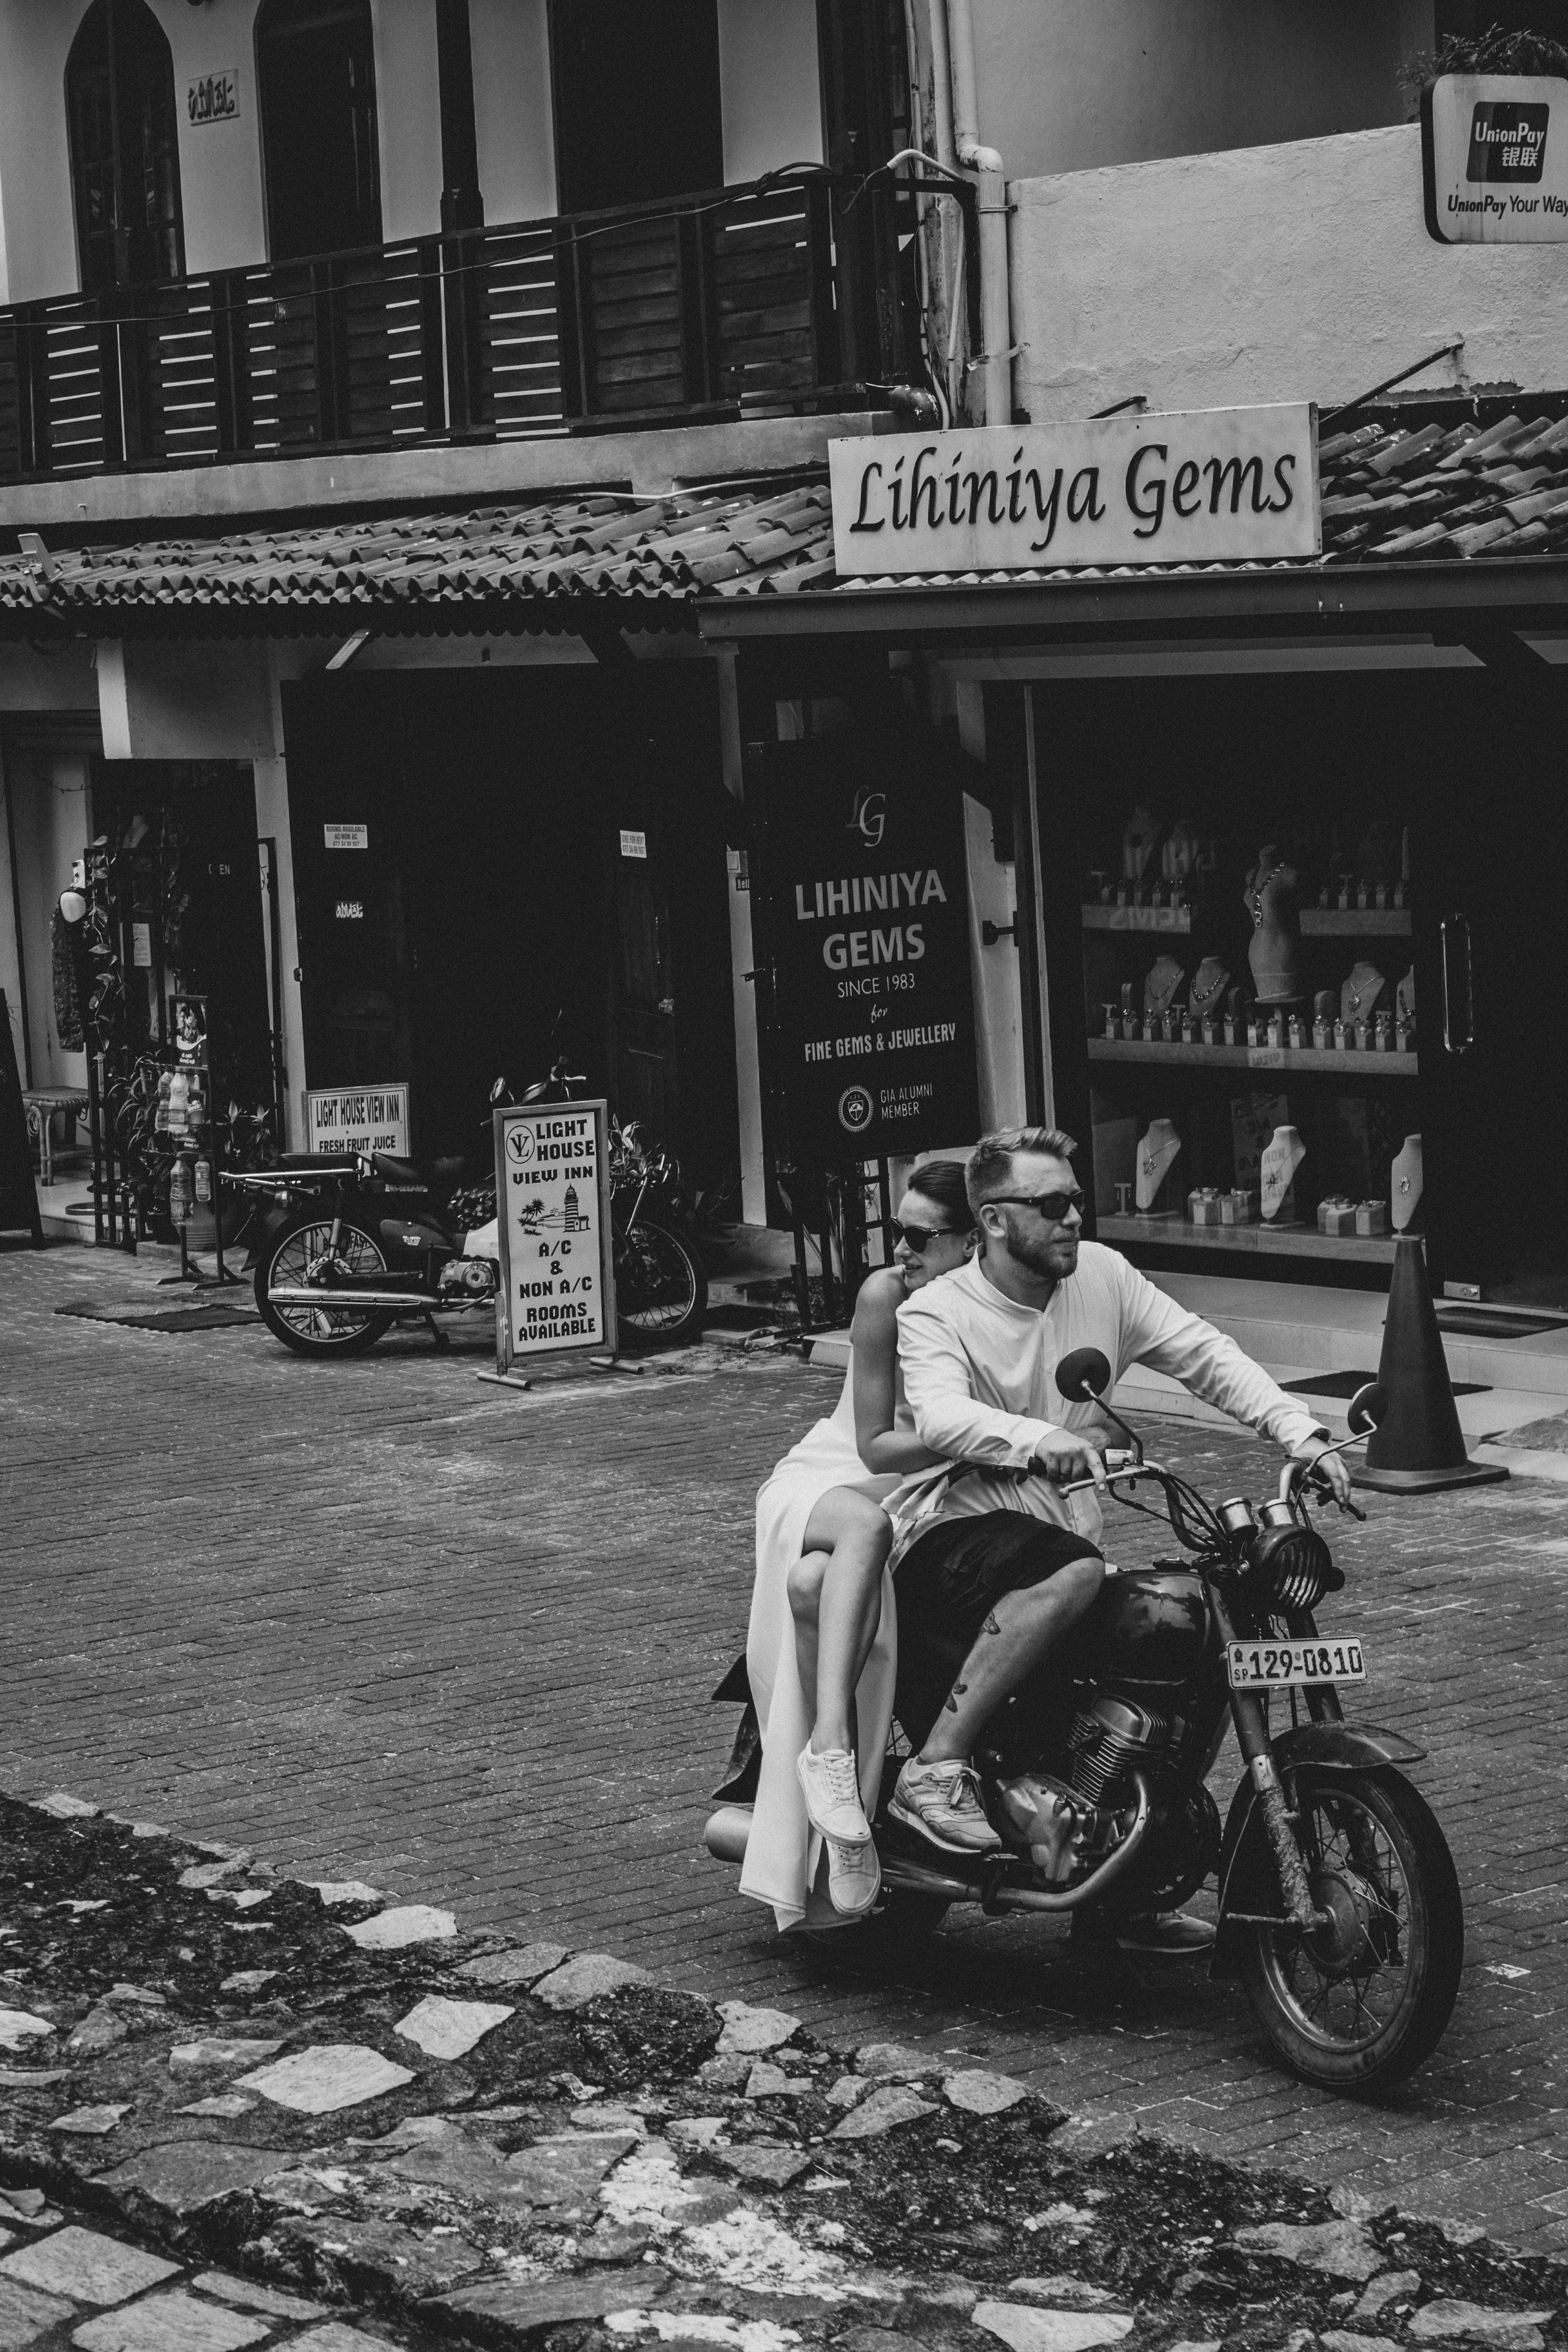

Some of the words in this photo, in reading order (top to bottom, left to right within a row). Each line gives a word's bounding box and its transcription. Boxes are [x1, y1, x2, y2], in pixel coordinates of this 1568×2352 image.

[1474, 122, 1545, 150] UnionPay
[1501, 146, 1539, 167] 银联
[1447, 195, 1507, 220] UnionPay
[1509, 195, 1540, 213] Your
[1542, 196, 1568, 217] Way
[848, 445, 1106, 552] Lihiniya
[1125, 443, 1297, 538] Gems
[737, 878, 750, 889] Bell
[796, 869, 948, 920] LIHINIYA
[823, 923, 925, 970] GEMS
[837, 977, 880, 998] SINCE
[886, 973, 915, 992] 1983
[870, 1003, 888, 1023] for
[804, 1040, 832, 1062] FINE
[835, 1035, 872, 1057] GEMS
[876, 1033, 884, 1052] &
[888, 1022, 956, 1050] JEWELLERY
[880, 1089, 896, 1103] GIA
[899, 1083, 933, 1101] ALUMNI
[316, 1099, 337, 1128] LIGHT
[340, 1096, 365, 1126] HOUSE
[366, 1095, 385, 1123] VIEW
[386, 1094, 399, 1122] INN
[881, 1101, 920, 1120] MEMBER
[535, 1118, 587, 1140] LIGHT
[319, 1139, 344, 1153] FRESH
[347, 1137, 370, 1152] FRUIT
[372, 1135, 396, 1150] JUICE
[537, 1140, 595, 1161] HOUSE
[512, 1169, 558, 1185] VIEW
[564, 1166, 594, 1180] INN
[538, 1240, 572, 1257] A/C
[550, 1260, 564, 1275] &
[519, 1280, 553, 1299] NON
[559, 1276, 593, 1294] A/C
[527, 1302, 587, 1323] ROOMS
[519, 1317, 596, 1342] AVAILABLE
[1234, 1668, 1248, 1681] SP
[1250, 1646, 1363, 1679] 129-0810
